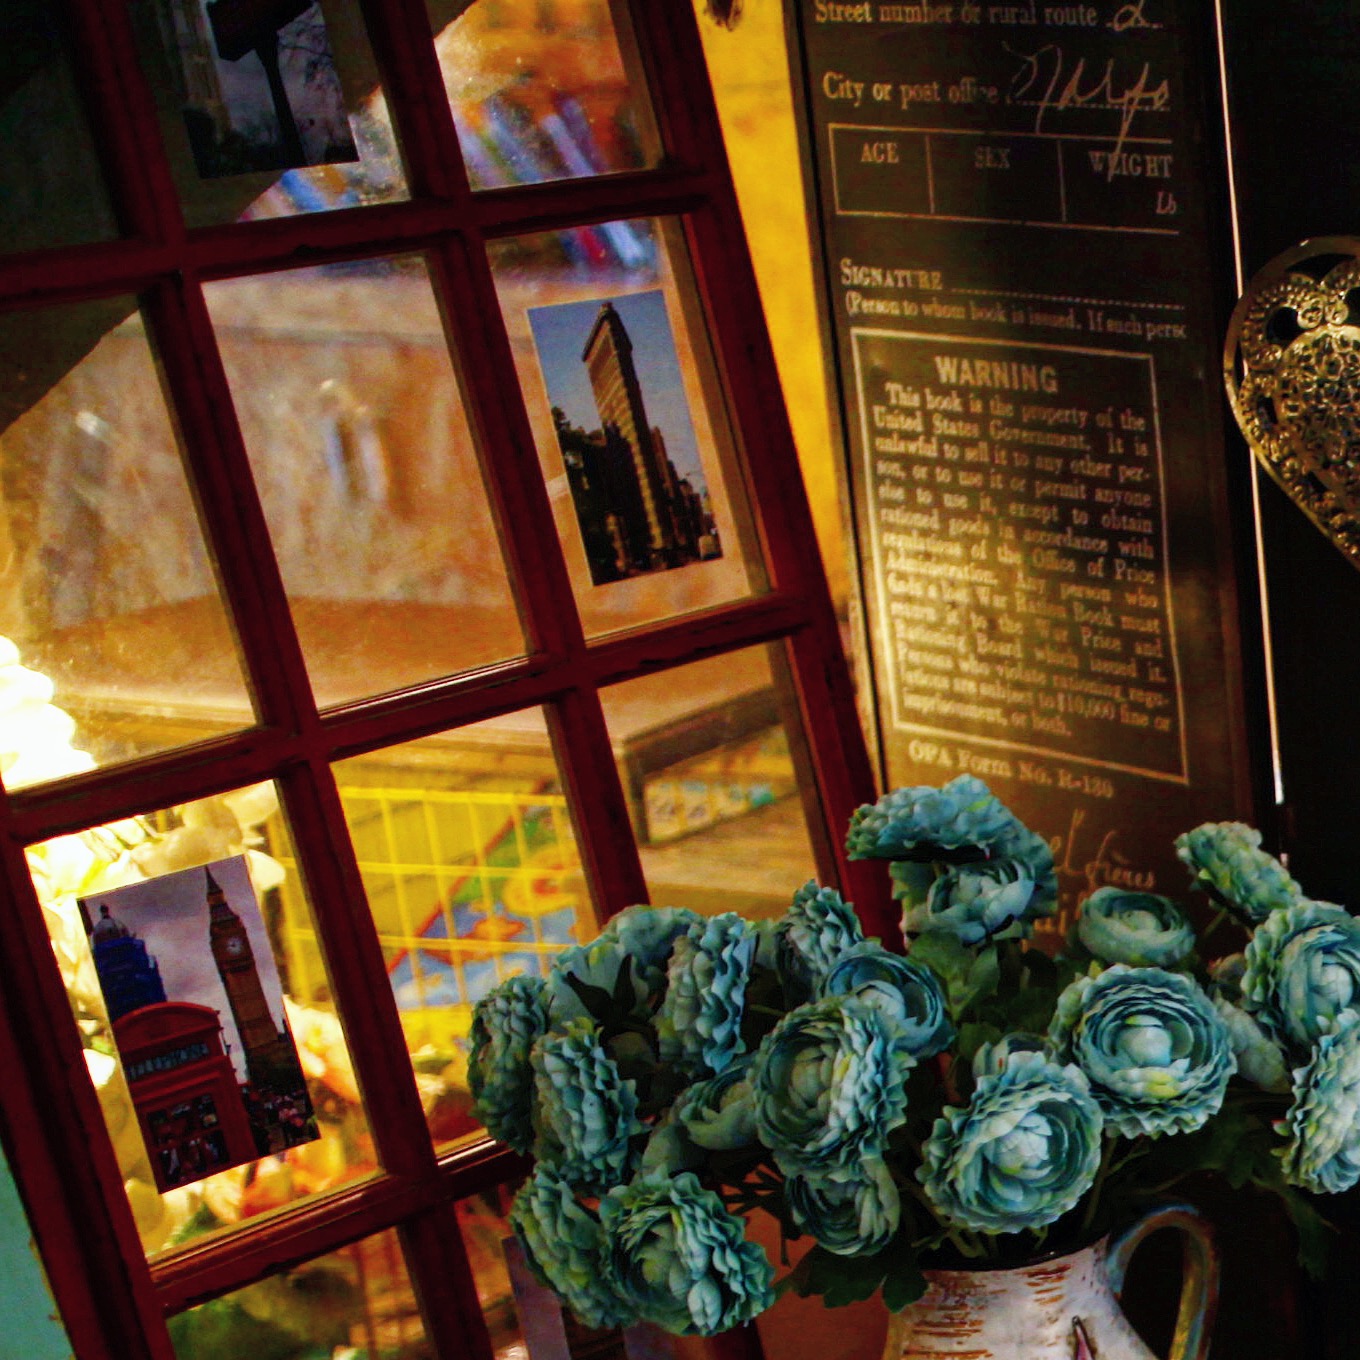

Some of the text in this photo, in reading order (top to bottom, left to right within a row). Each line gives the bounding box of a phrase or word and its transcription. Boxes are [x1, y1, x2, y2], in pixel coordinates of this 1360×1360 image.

[815, 0, 875, 24] Street
[879, 0, 953, 25] number
[990, 0, 1037, 25] rural
[1044, 5, 1098, 27] route
[822, 69, 865, 109] City
[871, 81, 894, 103] or
[899, 80, 941, 111] post
[861, 141, 1174, 179] AGE SEX WEIGHT
[904, 299, 918, 317] to
[921, 297, 967, 320] whom
[970, 301, 1008, 323] book
[1012, 305, 1025, 325] is
[1087, 308, 1104, 333] If
[1106, 313, 1143, 336] such
[934, 354, 1060, 394] WARNING
[885, 381, 920, 408] This
[925, 388, 963, 412] book
[1021, 404, 1088, 429] property
[872, 404, 923, 432] United
[932, 413, 979, 438] States
[989, 420, 1091, 450] Government.
[875, 431, 938, 458] unlawful
[964, 441, 990, 463] sell
[1070, 455, 1112, 479] other
[1035, 477, 1086, 502] permit
[1095, 487, 1152, 509] anyone
[1009, 502, 1059, 526] except
[1101, 508, 1153, 534] obtain
[1022, 527, 1108, 553] accordance
[1118, 539, 1154, 560] with
[1032, 547, 1076, 574] Office
[1114, 557, 1155, 585] Price
[1060, 581, 1112, 604] person
[1074, 600, 1116, 628] Book
[1120, 613, 1160, 634] must
[1081, 624, 1121, 650] Price
[958, 749, 1013, 779] Form
